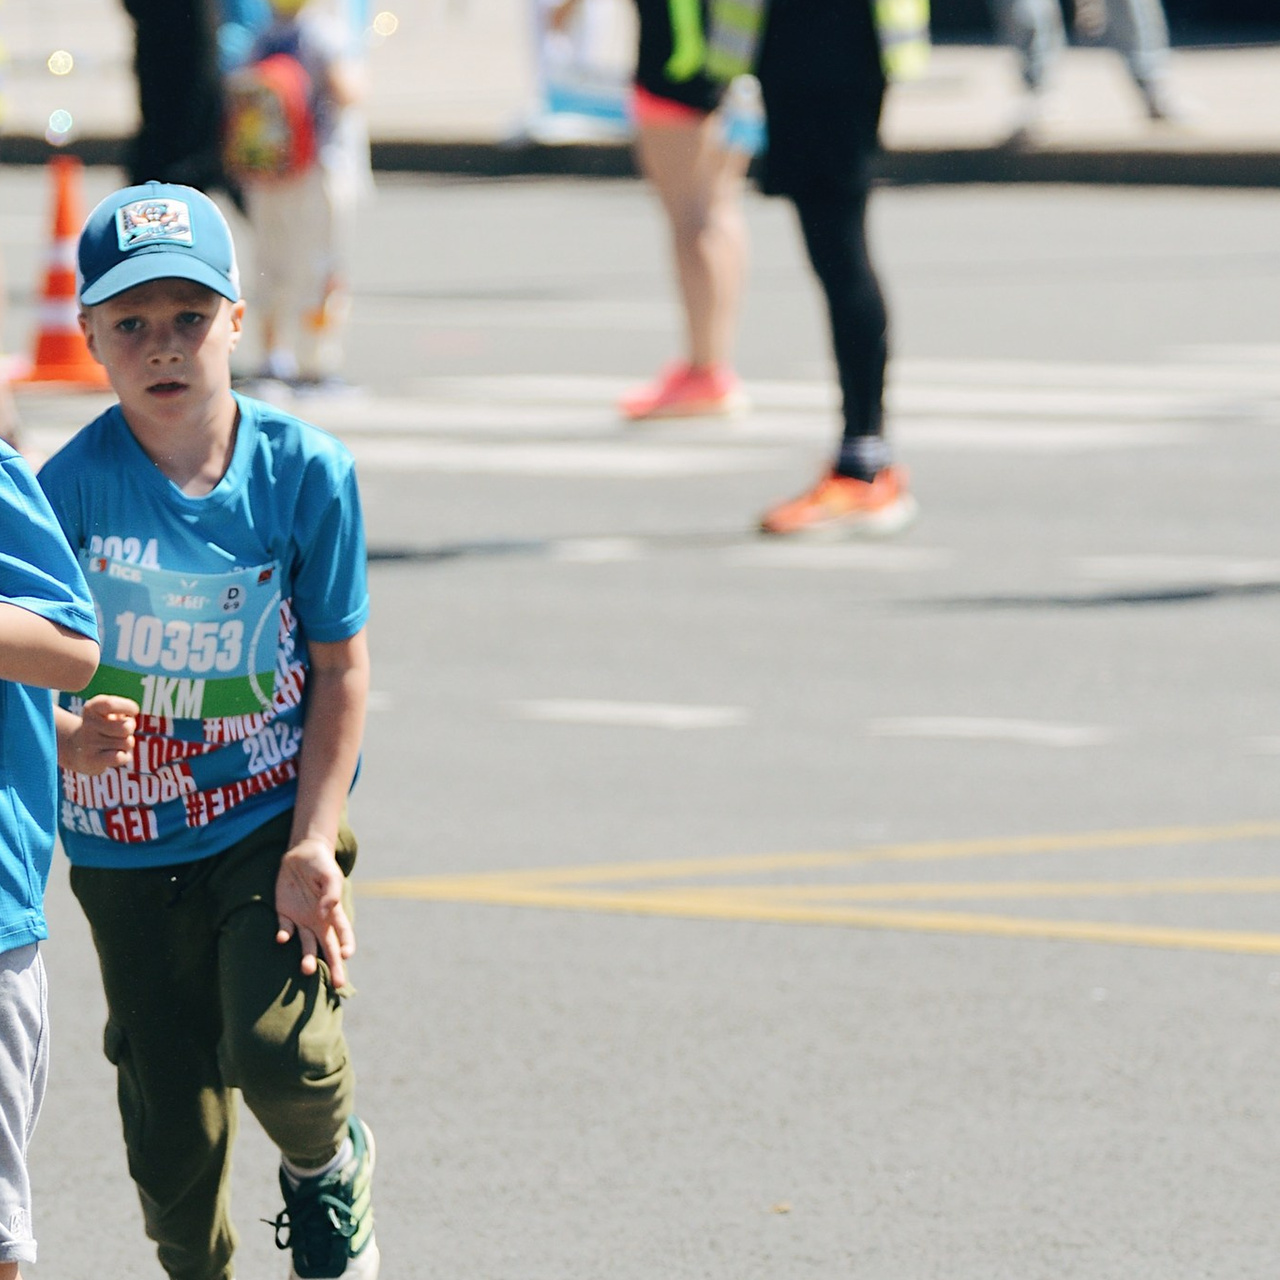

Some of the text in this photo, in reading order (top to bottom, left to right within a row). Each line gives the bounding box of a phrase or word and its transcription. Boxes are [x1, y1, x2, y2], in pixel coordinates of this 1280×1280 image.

[228, 587, 239, 600] D
[223, 600, 240, 612] 6-9
[115, 610, 244, 673] 10353
